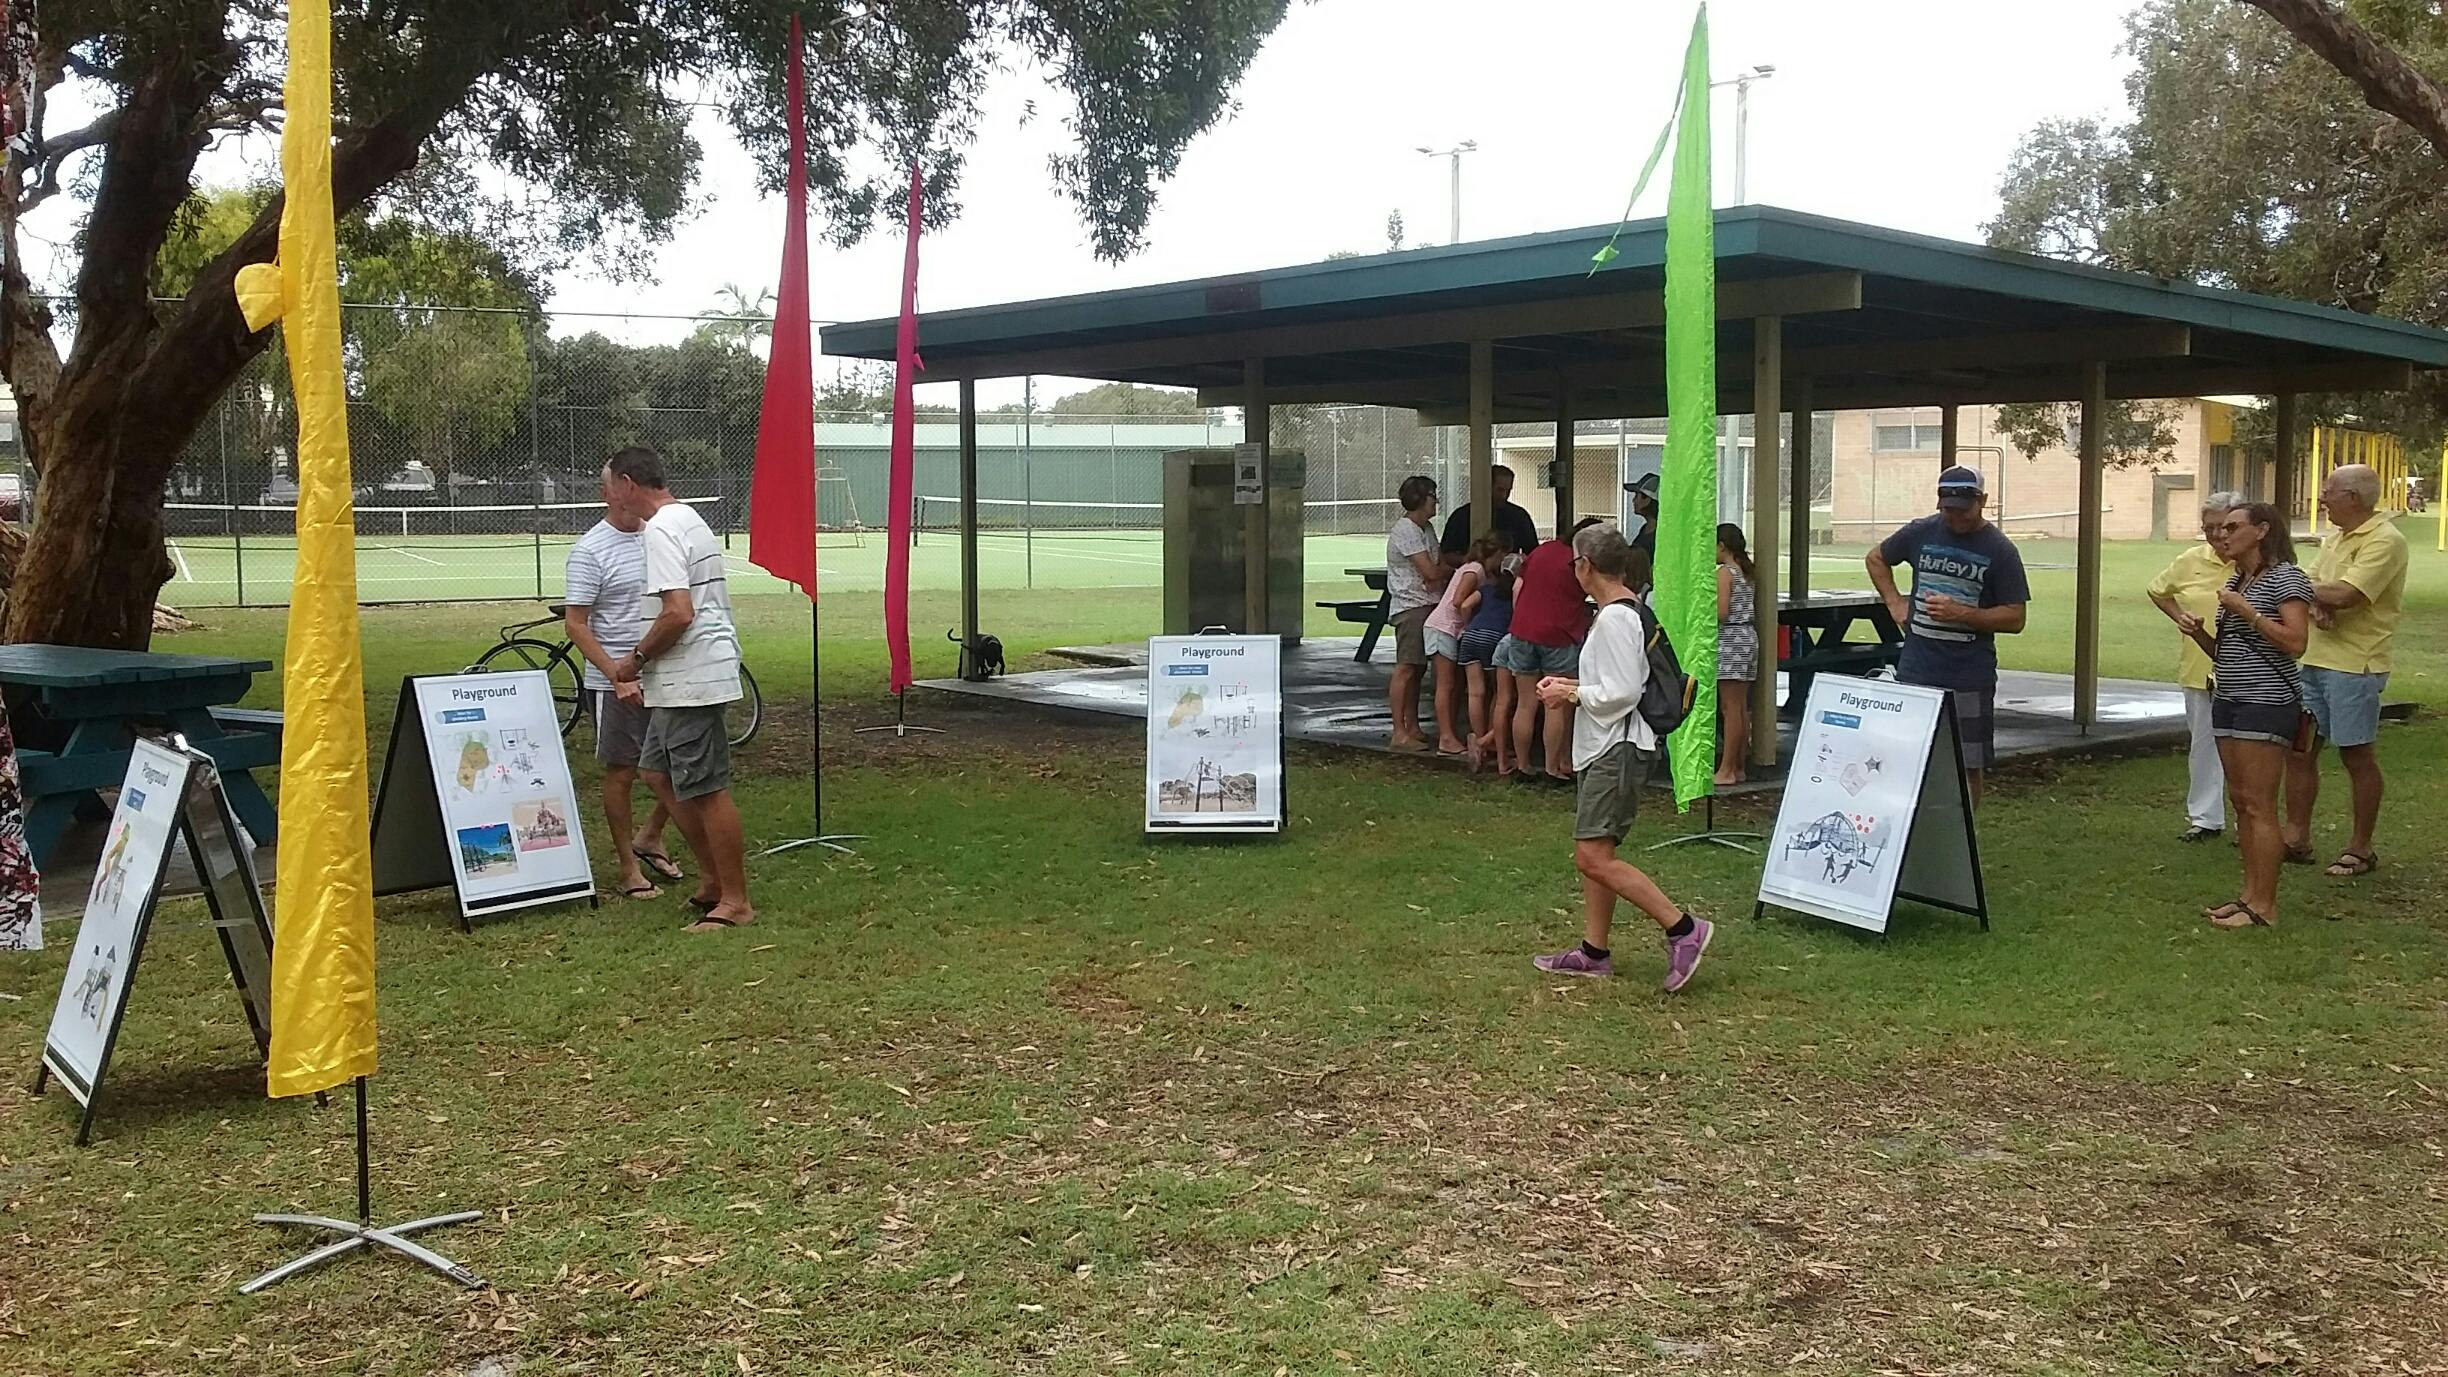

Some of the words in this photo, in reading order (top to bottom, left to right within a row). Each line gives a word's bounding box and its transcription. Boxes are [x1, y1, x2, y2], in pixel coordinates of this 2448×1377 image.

[1919, 554, 1968, 576] Hurley
[1182, 646, 1244, 659] Playground
[452, 684, 517, 701] Playground
[1840, 692, 1903, 713] Playground
